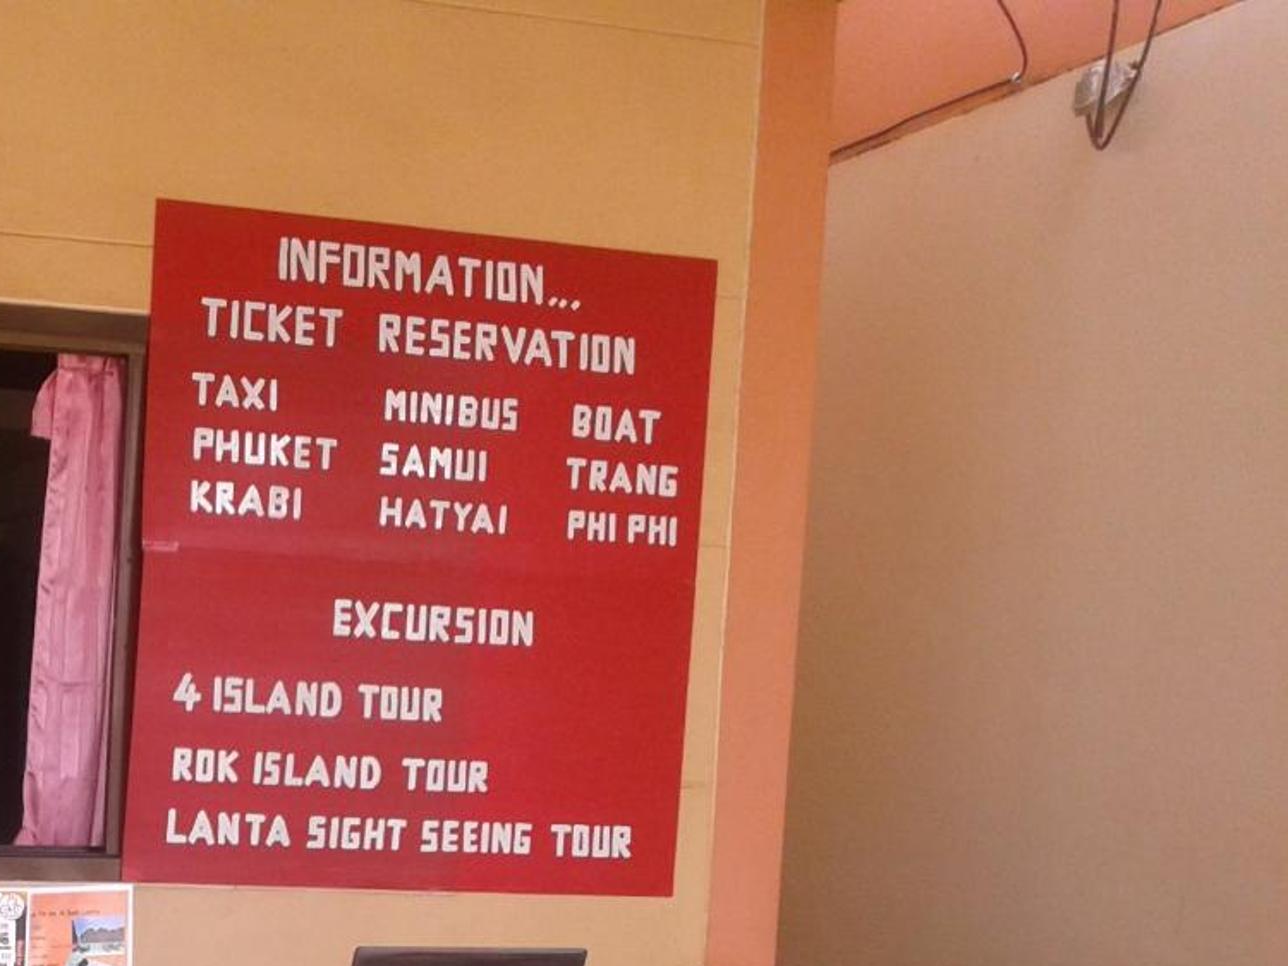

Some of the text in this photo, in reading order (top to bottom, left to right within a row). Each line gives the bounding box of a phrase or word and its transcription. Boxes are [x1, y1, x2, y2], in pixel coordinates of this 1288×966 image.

[202, 297, 636, 376] TICKET RESERVATION
[192, 372, 279, 411] TAXI
[384, 389, 519, 432] MINIBUS
[572, 404, 661, 445] BOAT
[192, 427, 338, 470] PHUKET
[379, 443, 488, 482] SAMUI
[566, 457, 679, 498] TRANG
[190, 480, 301, 520] KRABI
[379, 497, 508, 536] HATYAI
[567, 510, 678, 547] PHI PHI
[332, 598, 534, 647] EXCURSION
[173, 672, 443, 722] 4 ISLAND TOUR
[172, 747, 488, 793] ROK ISLAND TOUR
[166, 808, 632, 859] LANTA SIGHT SEEING TOUR
